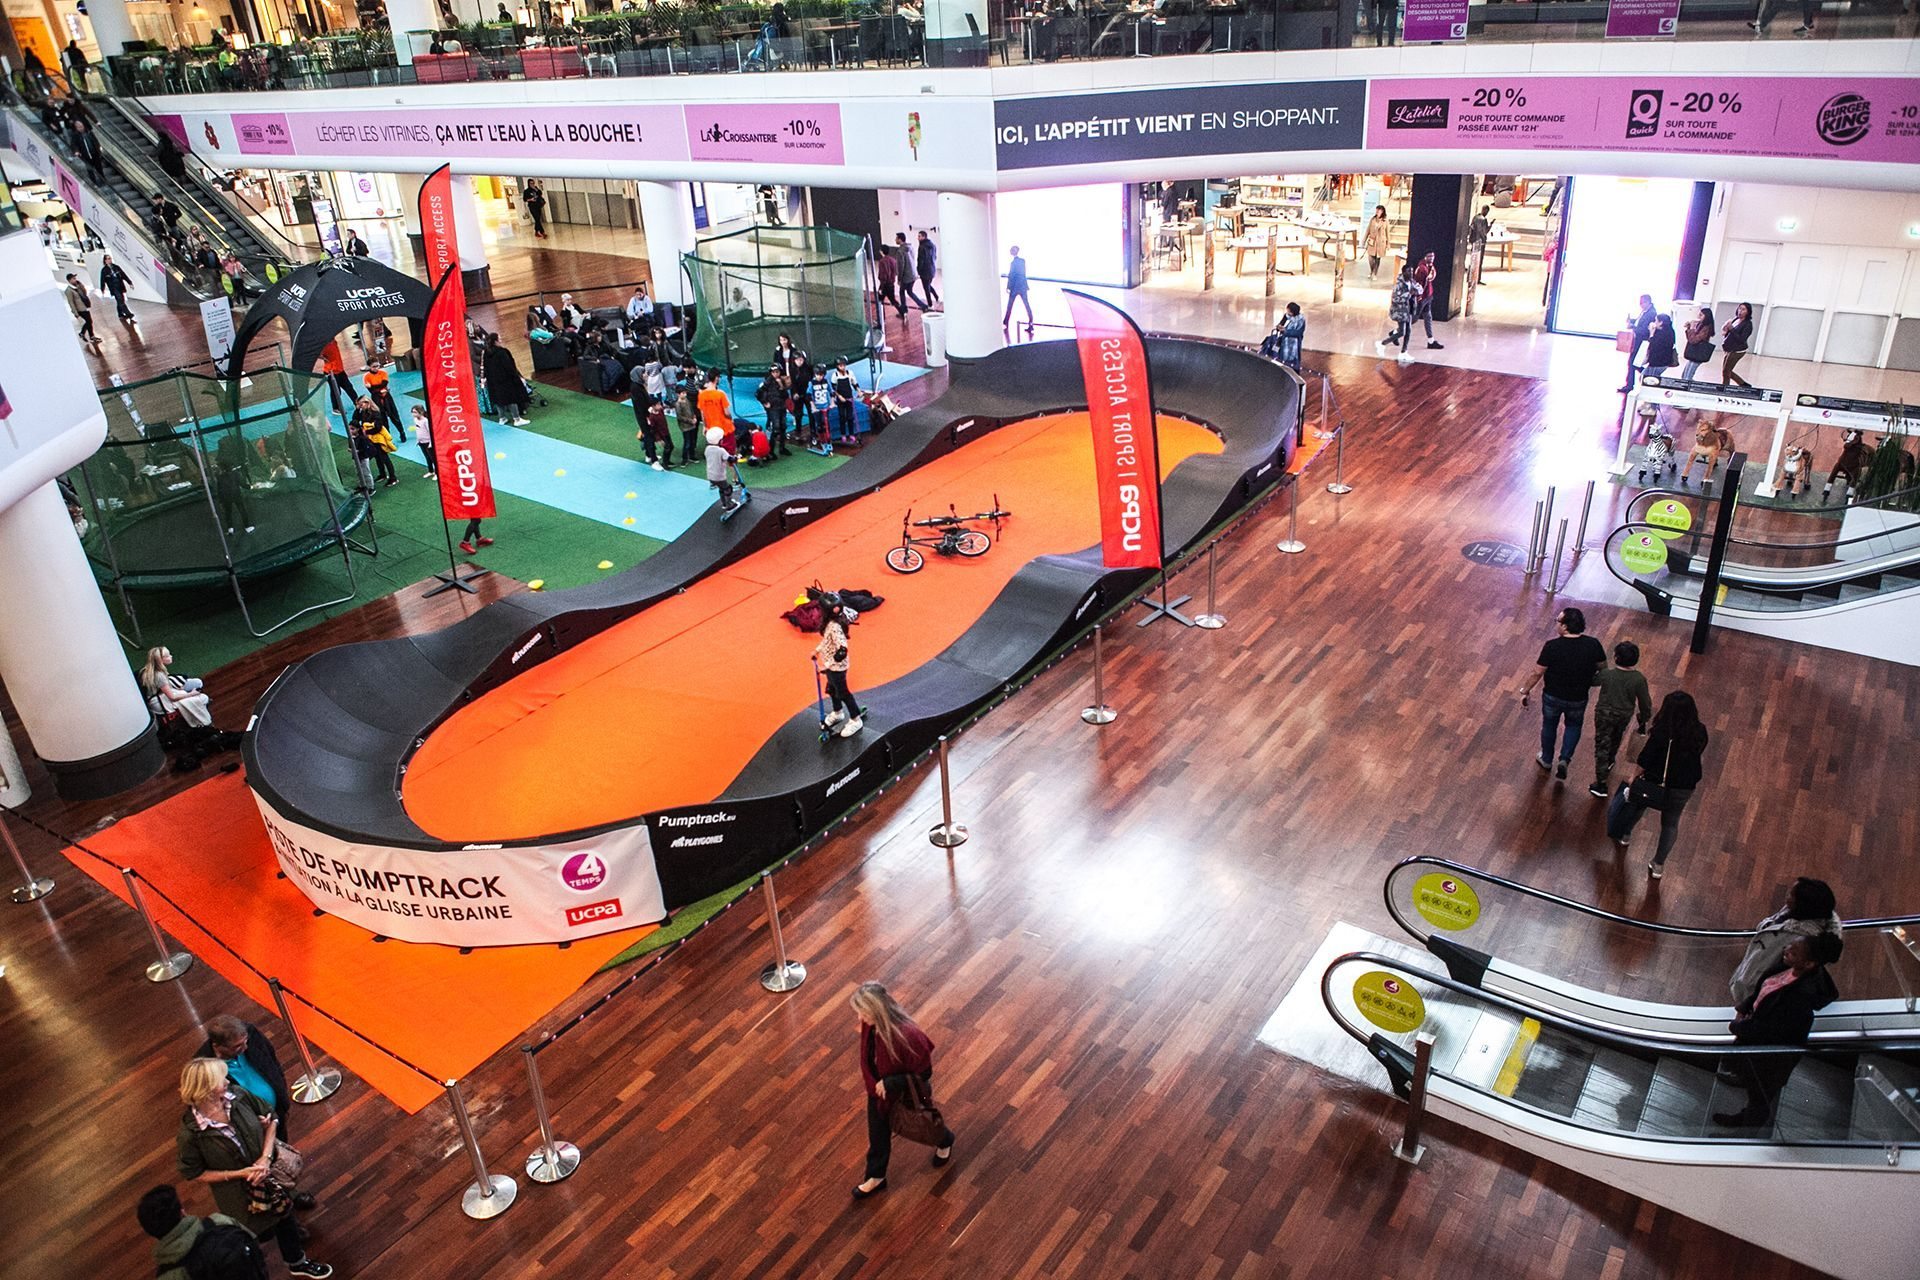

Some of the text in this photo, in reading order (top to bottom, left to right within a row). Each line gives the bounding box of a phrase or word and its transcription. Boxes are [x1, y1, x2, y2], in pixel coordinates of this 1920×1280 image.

[1823, 101, 1871, 121] BURGER
[1823, 111, 1870, 133] KING
[316, 122, 357, 142] LÉCHER
[358, 125, 379, 142] LES
[380, 125, 433, 144] VITRINES,
[436, 125, 454, 146] ÇA
[457, 125, 483, 142] MET
[488, 125, 526, 142] L'EAU
[531, 119, 541, 142] À
[544, 124, 565, 142] LA
[723, 129, 778, 143] CROISSANTERIE
[997, 107, 1339, 145] ICI, L'APPÉTIT VIENT EN SHOPPANT.
[1458, 124, 1489, 132] PASSÉE
[1629, 126, 1654, 135] Quick
[1665, 120, 1717, 129] SUR TOUTE
[430, 195, 450, 272] SPORT ACCESS
[336, 295, 406, 312] SPORT ACCESS
[438, 321, 456, 379] ACCESS
[445, 387, 467, 432] SPORT
[300, 847, 331, 876] DE
[331, 859, 506, 900] PUMPTRACK
[577, 852, 601, 876] 4
[569, 876, 601, 887] TEMPS
[333, 881, 344, 899] À
[345, 889, 364, 906] LA
[365, 896, 423, 917] GLISSE
[426, 905, 512, 922] URBAINE
